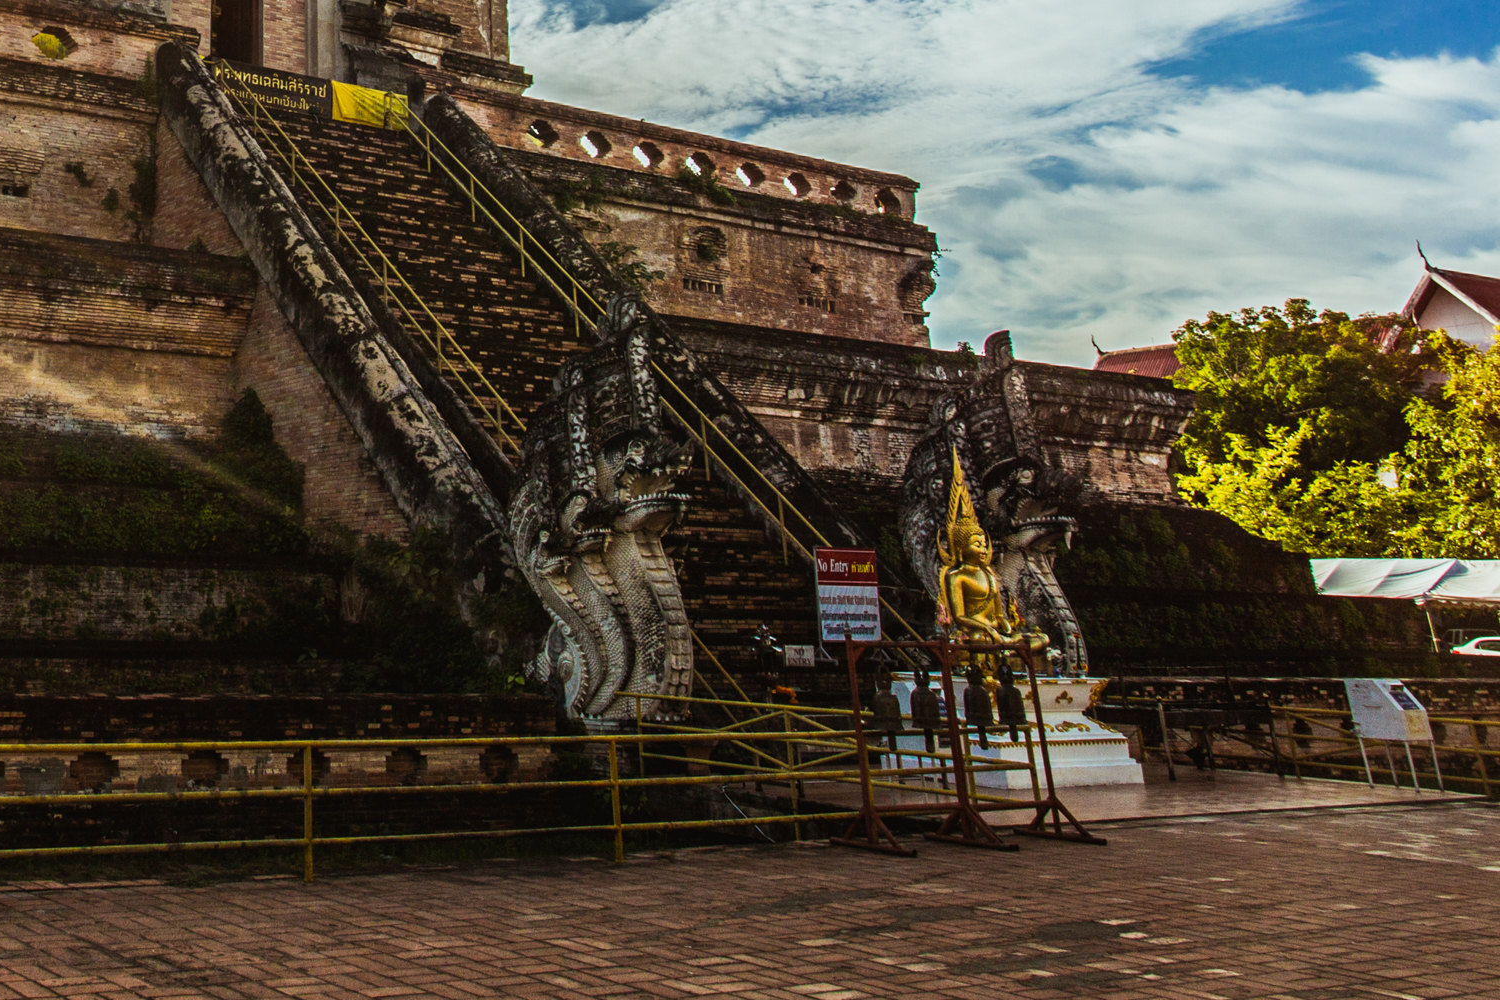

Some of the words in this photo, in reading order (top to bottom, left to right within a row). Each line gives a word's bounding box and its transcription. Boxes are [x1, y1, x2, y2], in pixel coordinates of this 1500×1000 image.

[818, 558, 828, 572] No
[830, 559, 849, 576] Entry
[794, 648, 804, 656] NO
[788, 657, 811, 665] ENTRY
